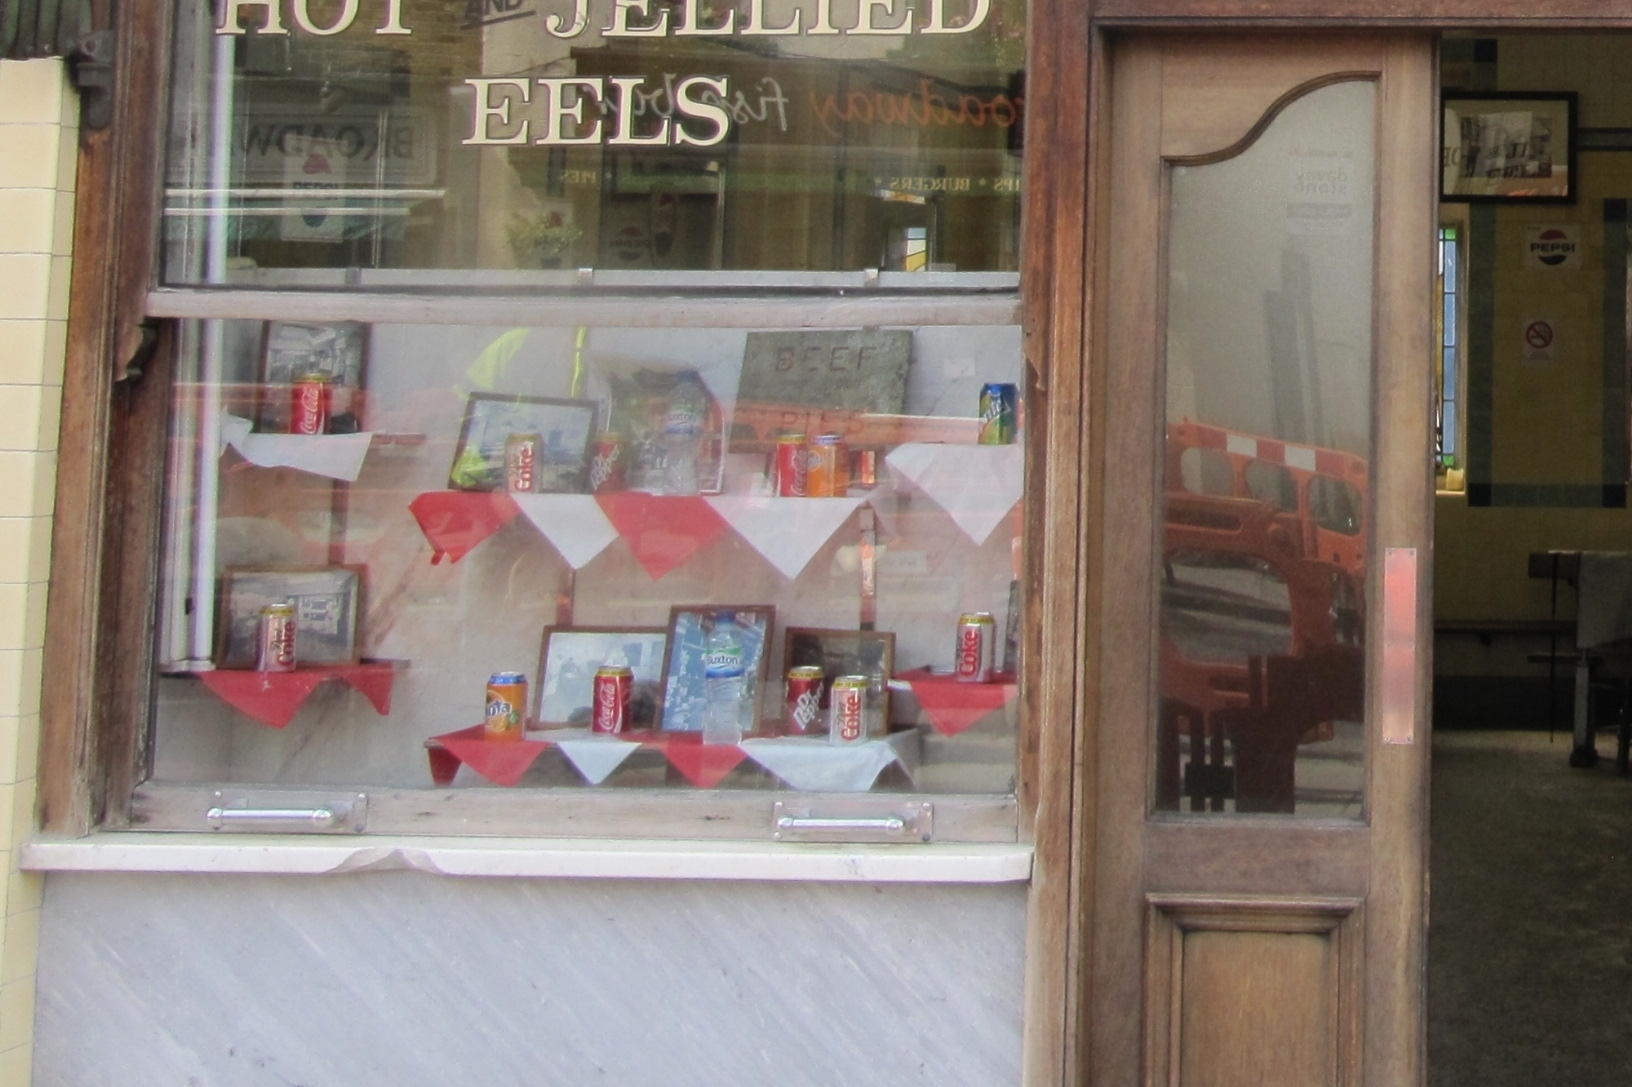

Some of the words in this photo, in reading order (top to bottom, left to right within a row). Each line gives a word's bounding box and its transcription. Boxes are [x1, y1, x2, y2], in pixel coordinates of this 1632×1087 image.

[461, 75, 731, 147] EELS
[1529, 243, 1576, 253] PEPSI
[776, 346, 878, 372] BEEF
[514, 448, 535, 492] Coke
[277, 621, 296, 666] Coke
[959, 630, 979, 677] Coke
[841, 695, 862, 741] Coke
